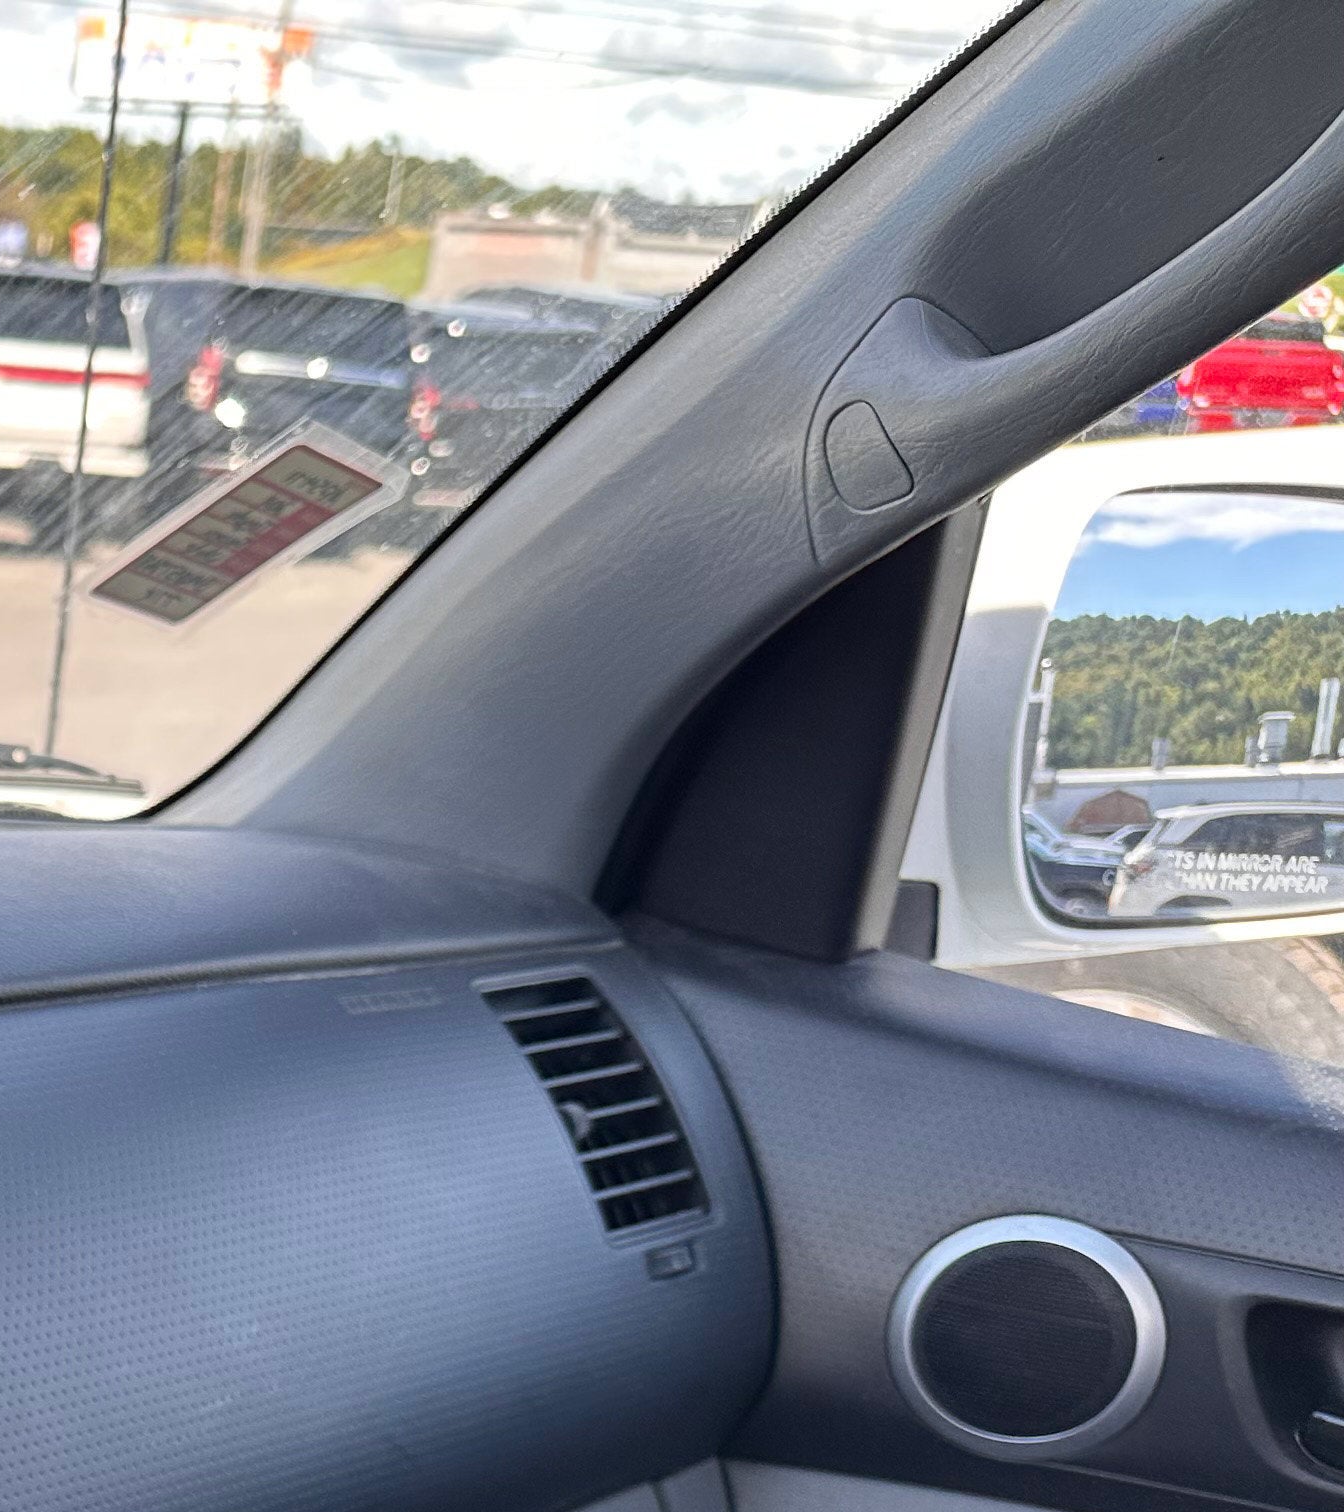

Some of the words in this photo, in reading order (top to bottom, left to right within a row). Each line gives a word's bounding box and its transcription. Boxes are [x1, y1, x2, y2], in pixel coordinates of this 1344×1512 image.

[1217, 853, 1283, 873] MIRROR
[1285, 856, 1320, 875] ARE
[1220, 872, 1262, 892] THEY
[1262, 874, 1329, 894] APPEAR
